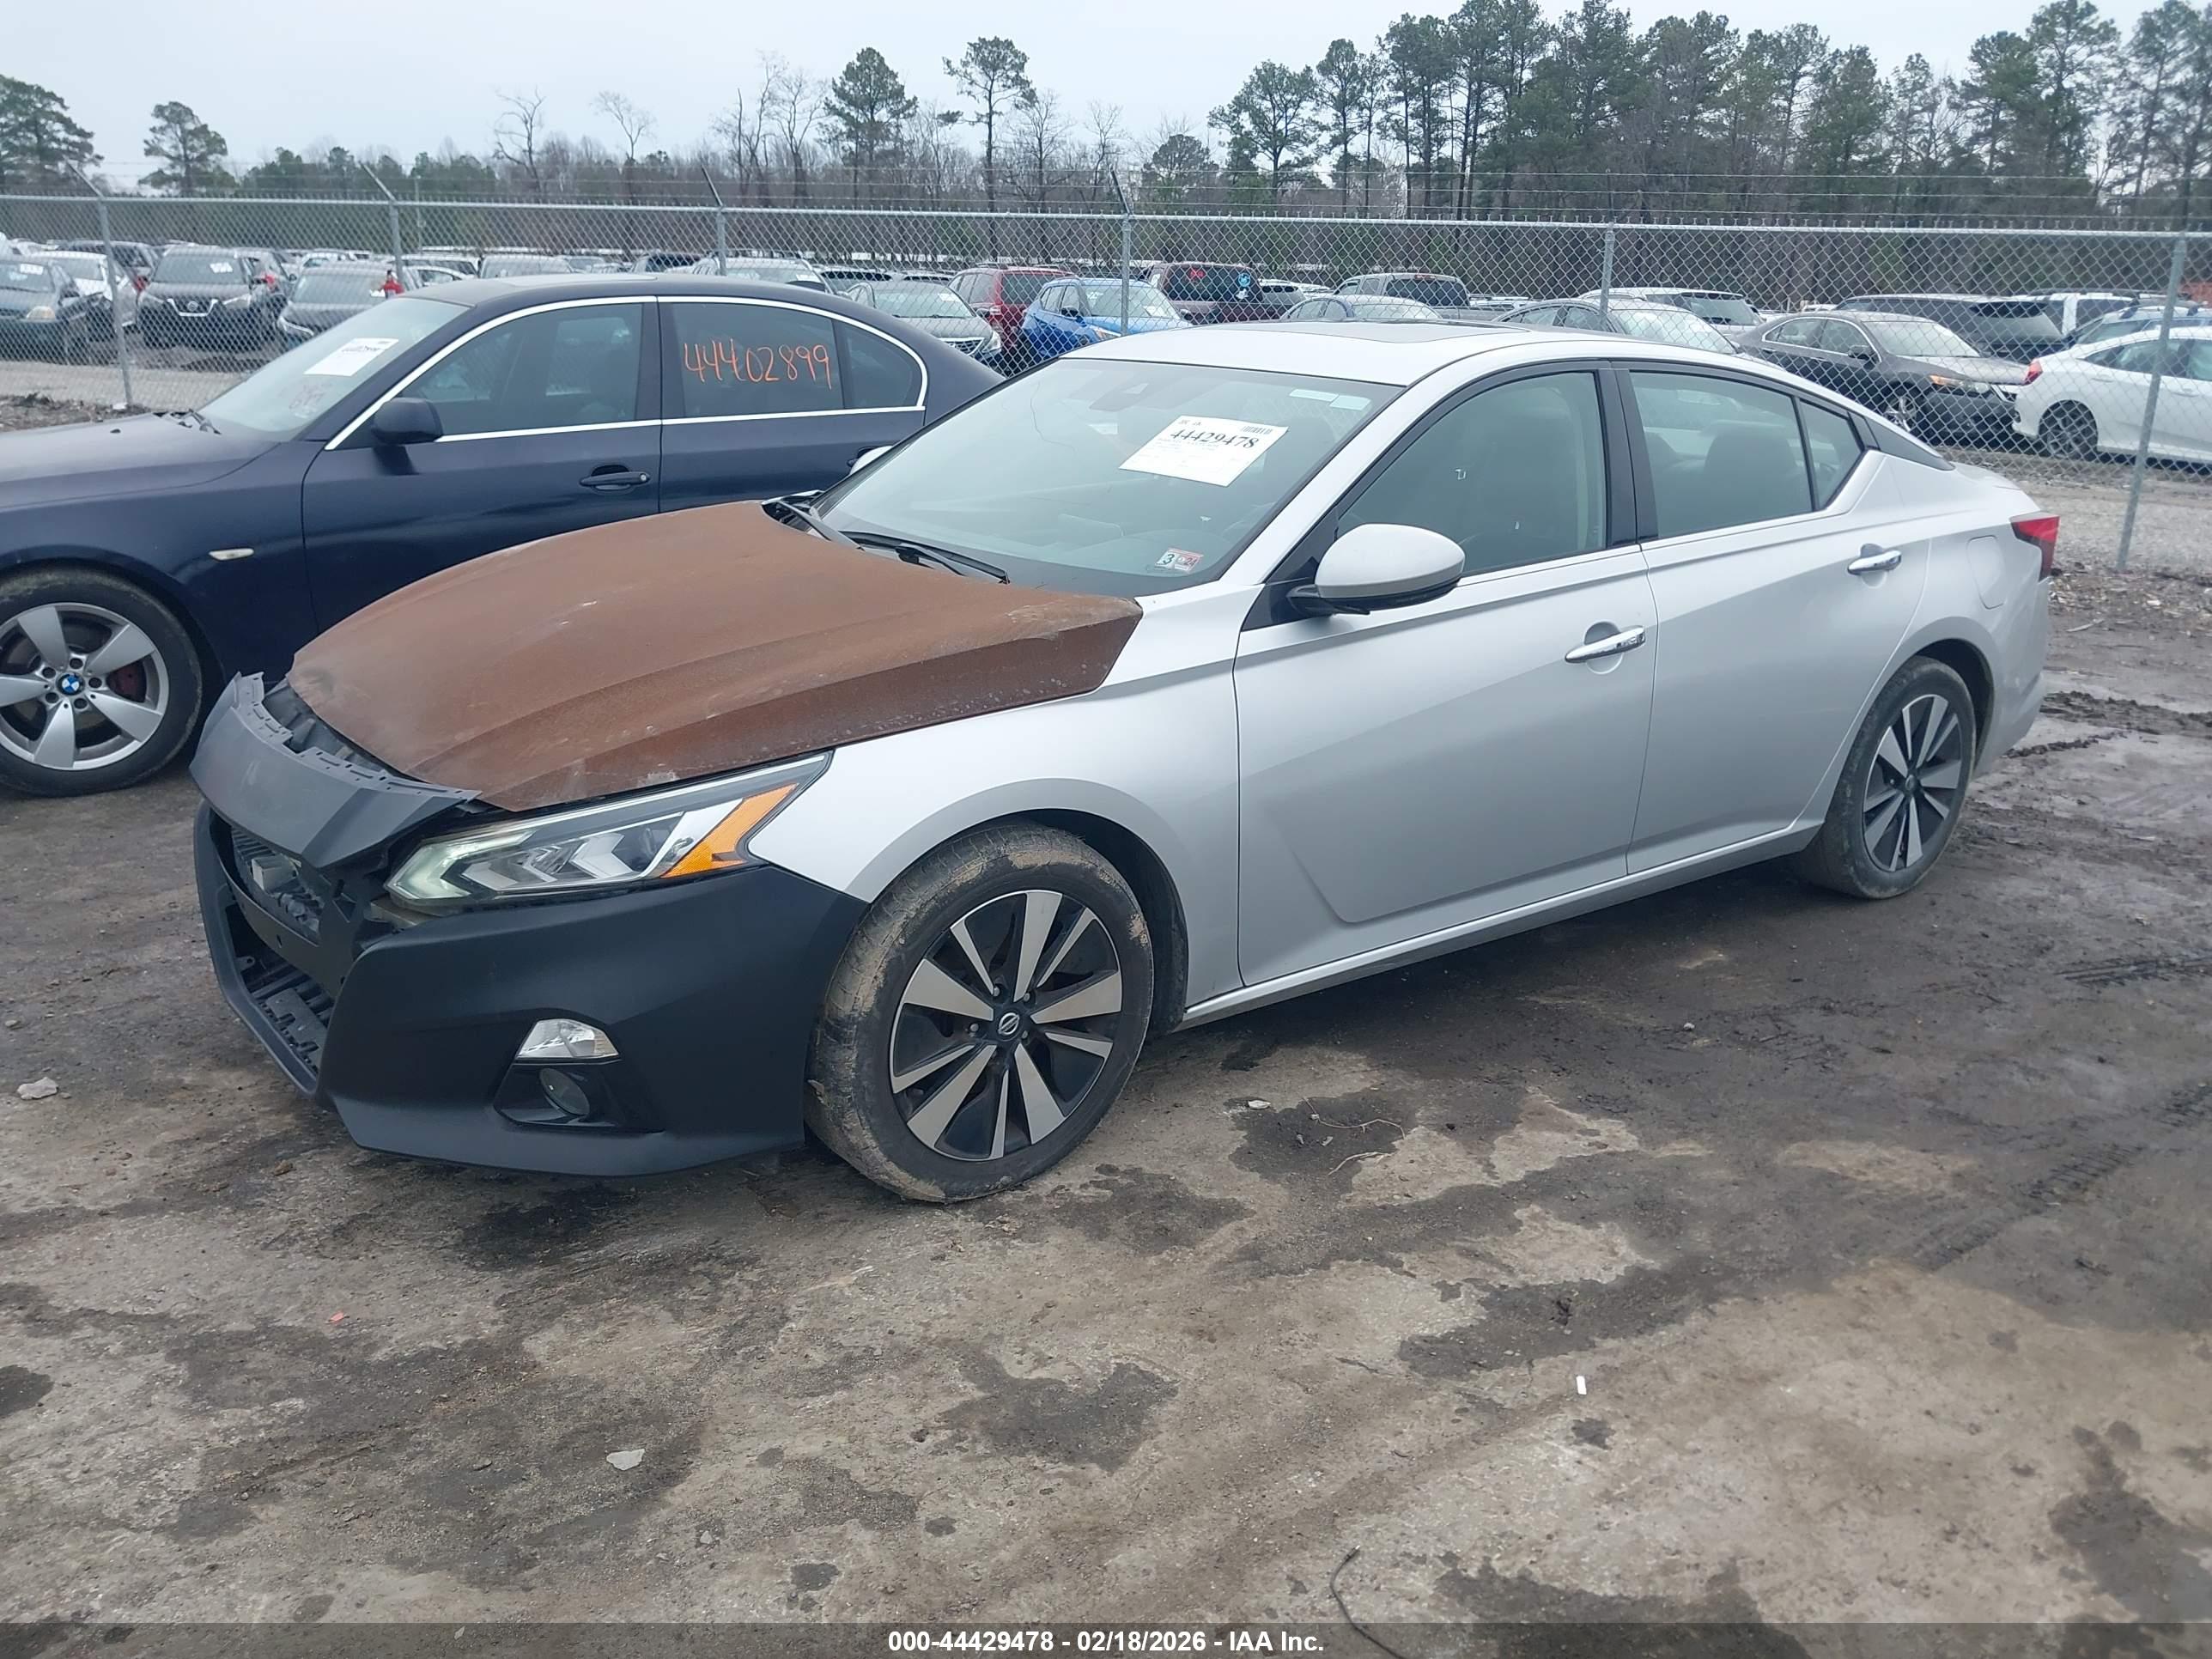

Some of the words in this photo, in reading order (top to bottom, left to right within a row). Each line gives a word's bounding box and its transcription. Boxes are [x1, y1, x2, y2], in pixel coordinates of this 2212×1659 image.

[684, 337, 832, 391] 44402899
[1170, 428, 1260, 449] 44429478
[1162, 553, 1176, 565] 3
